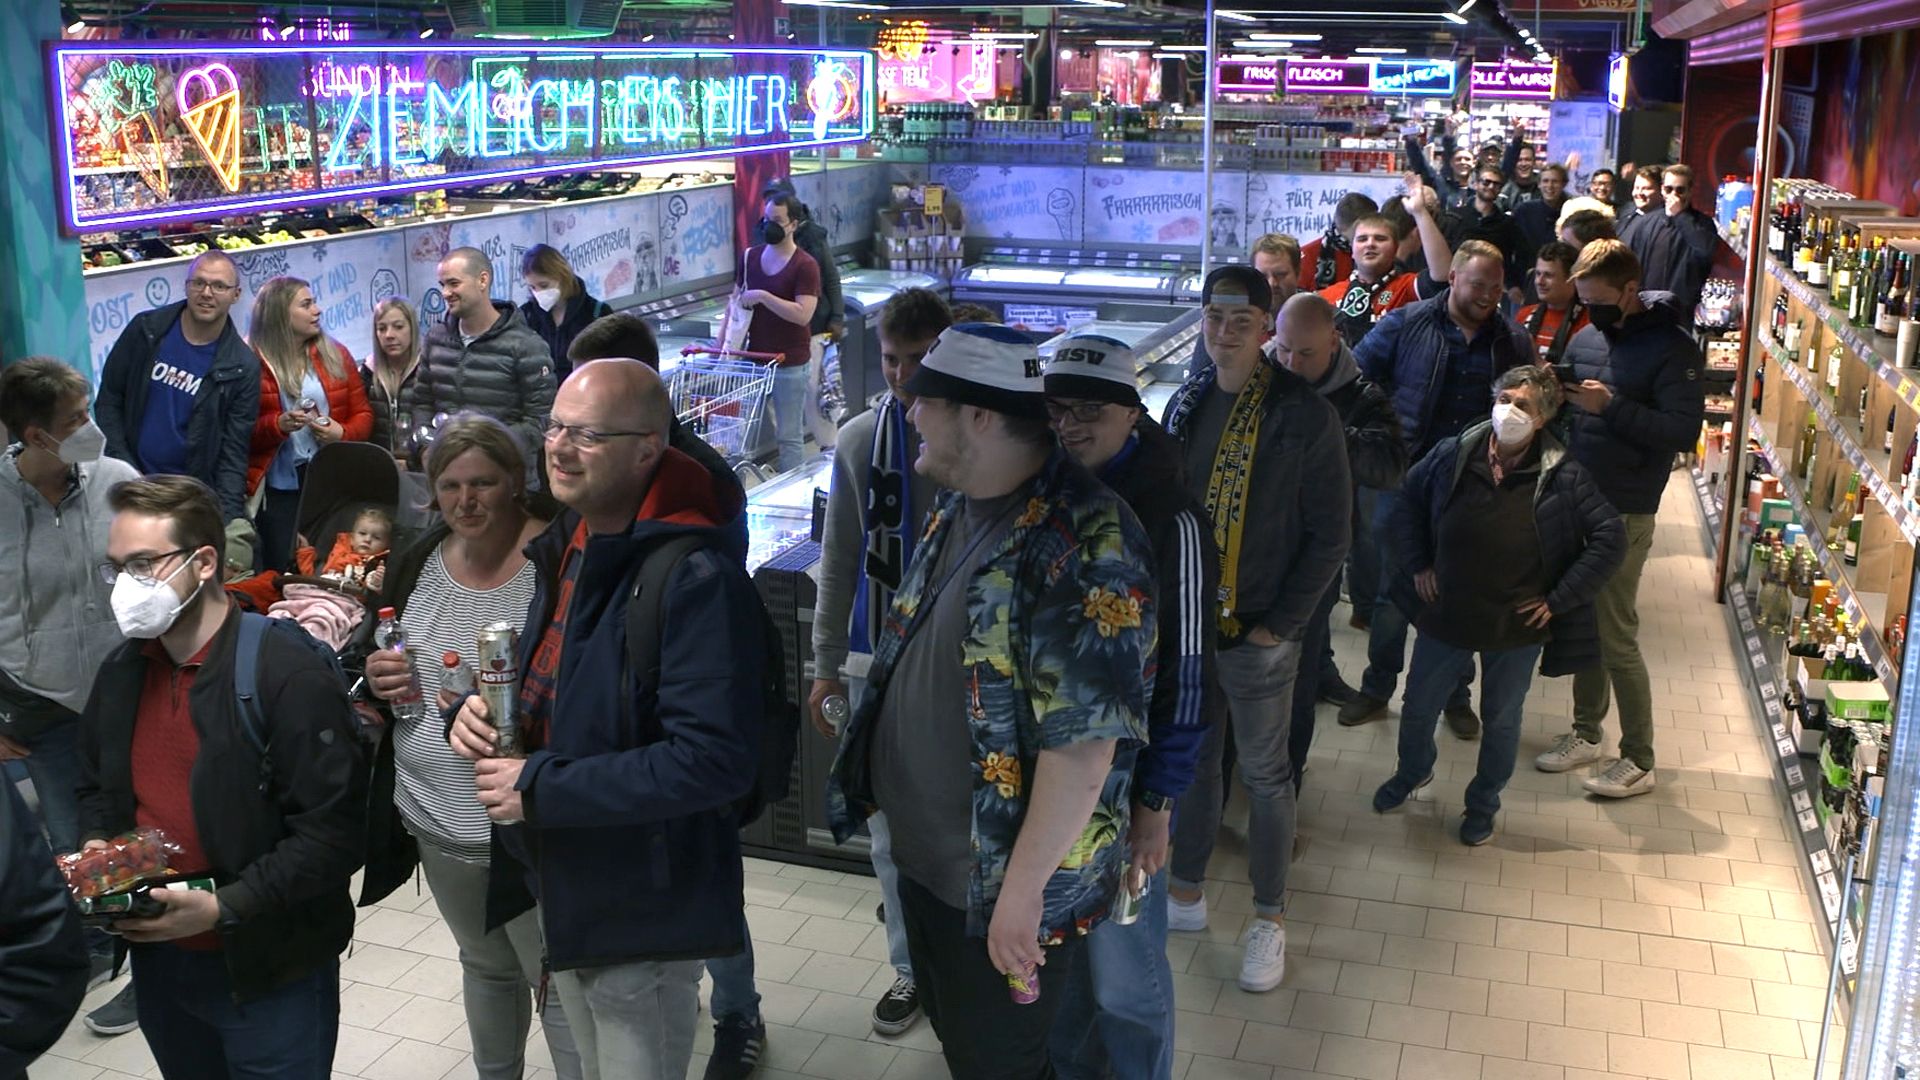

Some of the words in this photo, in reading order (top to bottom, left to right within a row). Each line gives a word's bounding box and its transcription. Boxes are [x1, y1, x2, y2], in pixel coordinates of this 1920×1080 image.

[1243, 66, 1278, 80] FRISC
[1288, 67, 1343, 81] FLEISCH
[622, 74, 684, 143] EIS
[700, 73, 788, 138] HIER
[1286, 188, 1313, 210] FÜR
[328, 262, 358, 295] UND
[1343, 290, 1370, 313] 96
[1023, 357, 1045, 379] H
[1055, 347, 1106, 367] HSV
